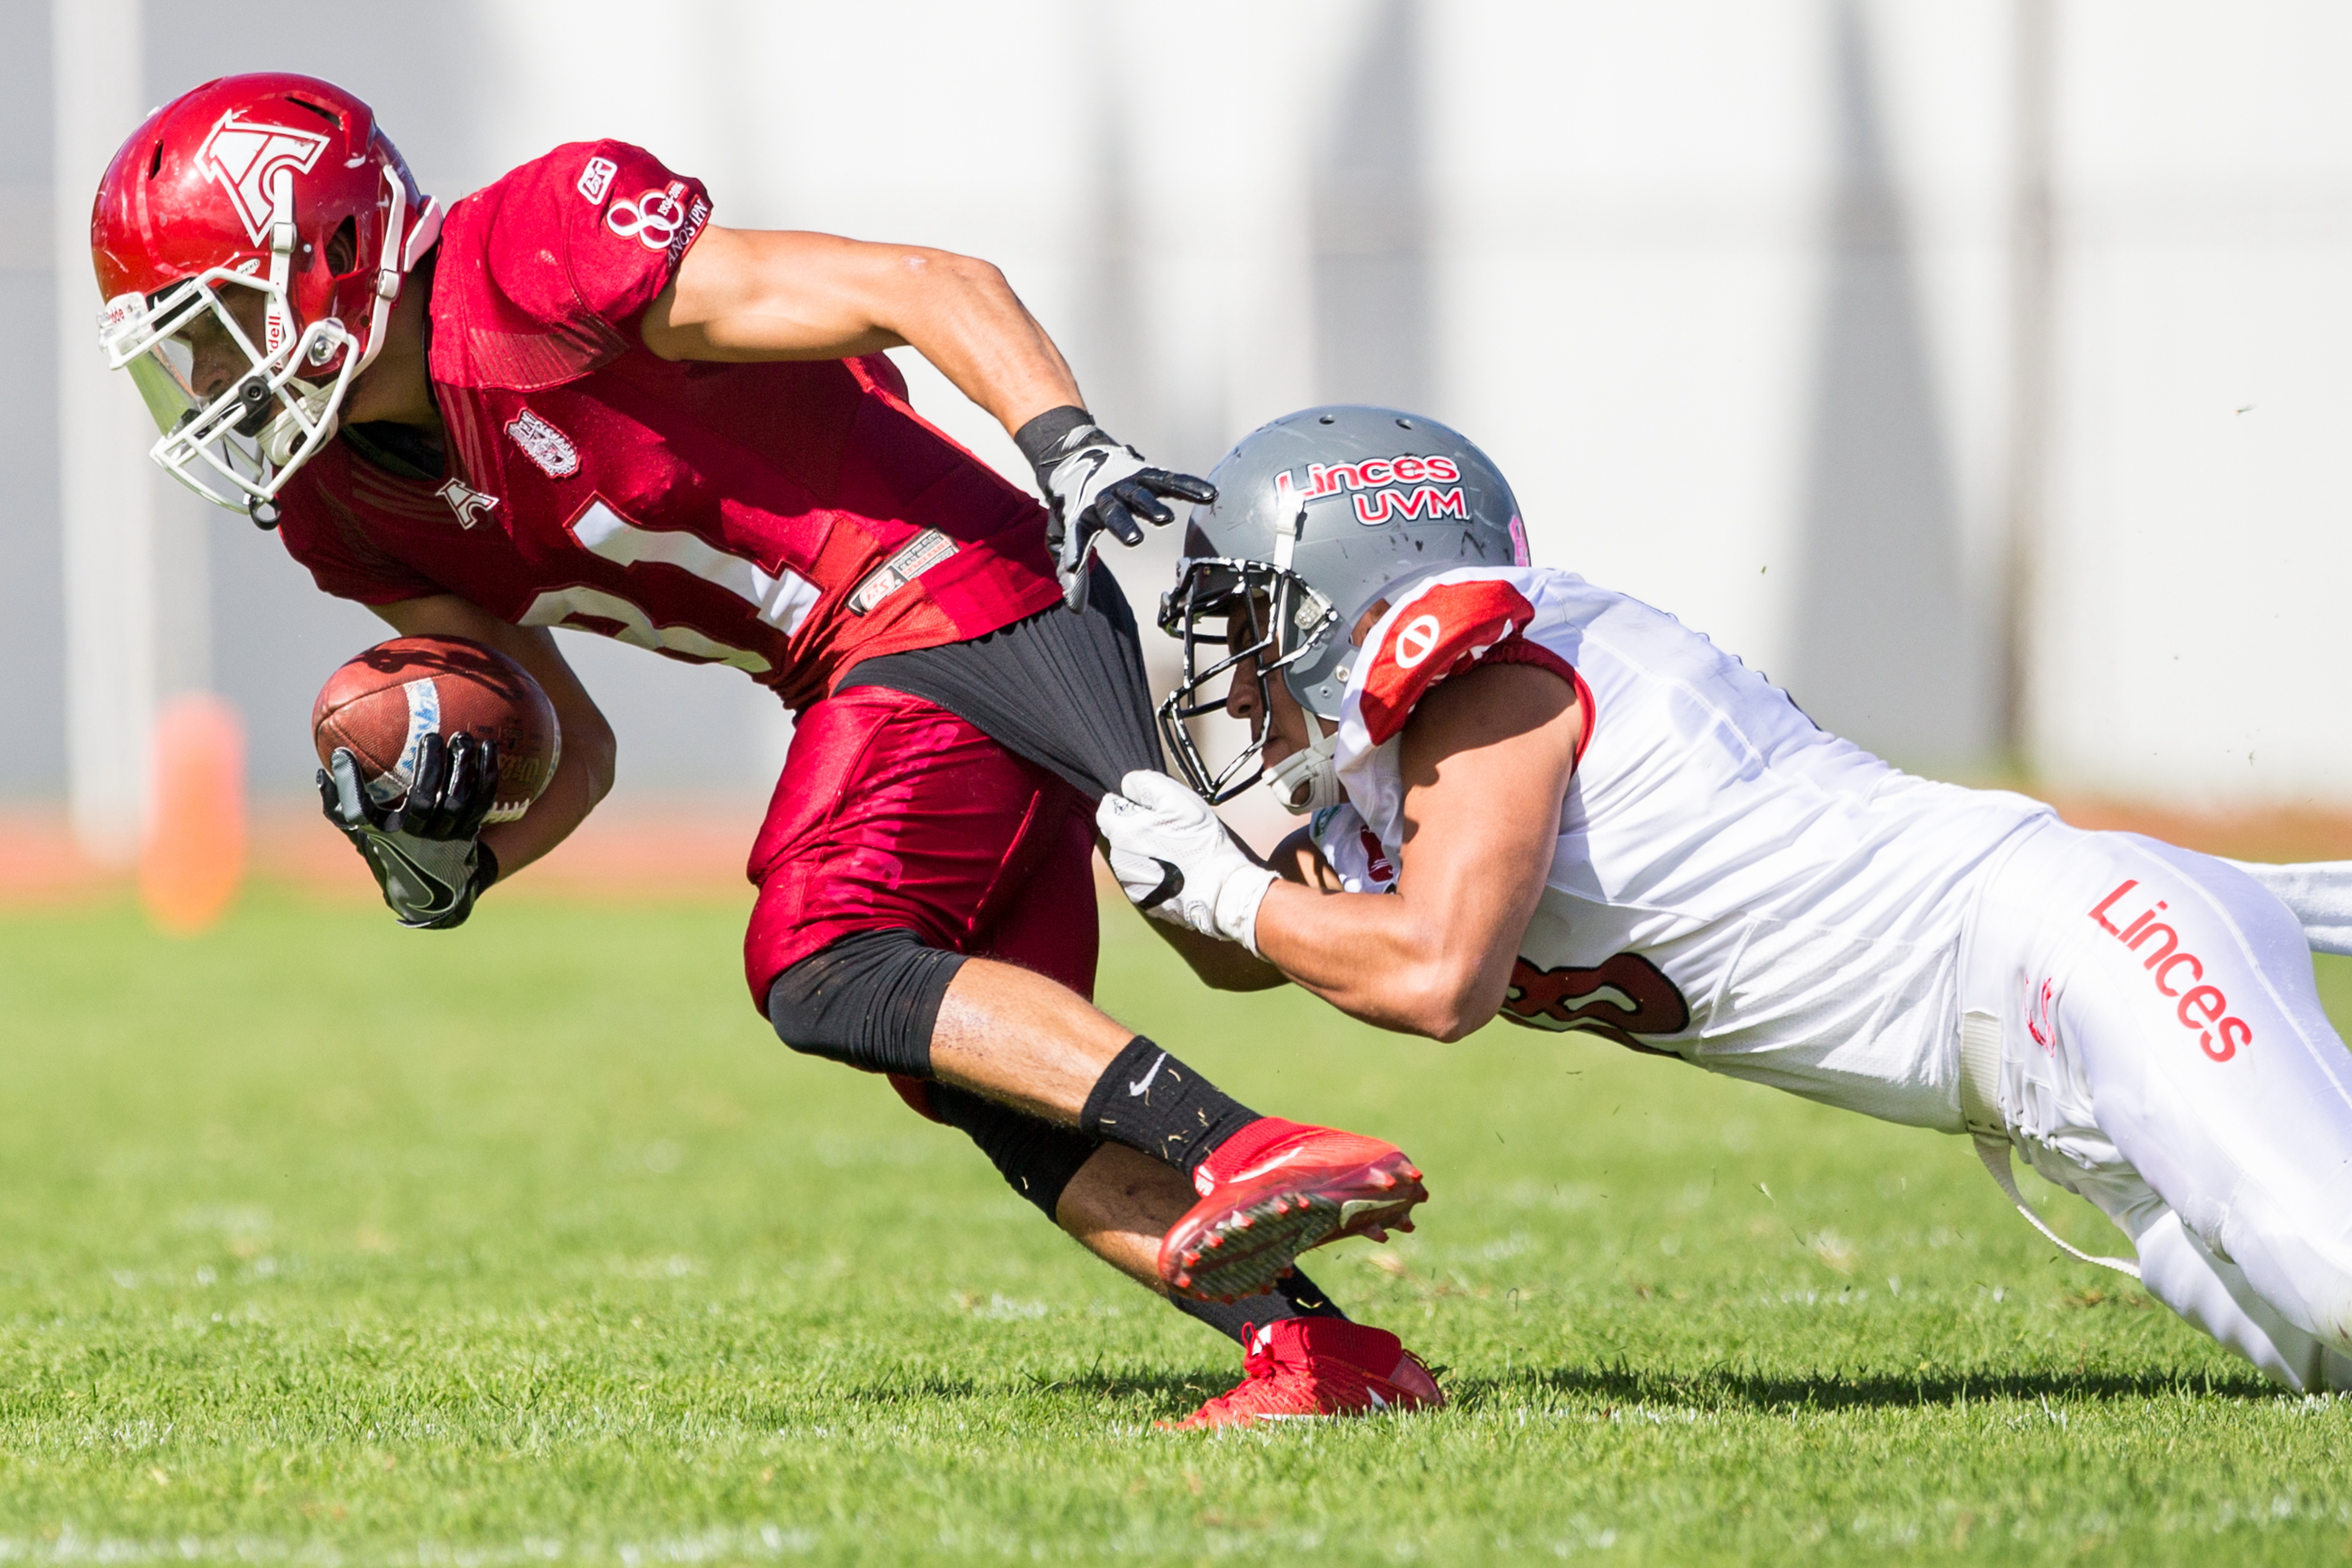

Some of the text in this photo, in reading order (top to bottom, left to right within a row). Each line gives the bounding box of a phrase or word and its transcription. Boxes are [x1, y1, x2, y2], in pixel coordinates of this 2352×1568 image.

[689, 198, 708, 227] IPN
[1277, 456, 1459, 500] Linces
[1354, 487, 1467, 525] UVM
[2087, 879, 2253, 1063] Linces
